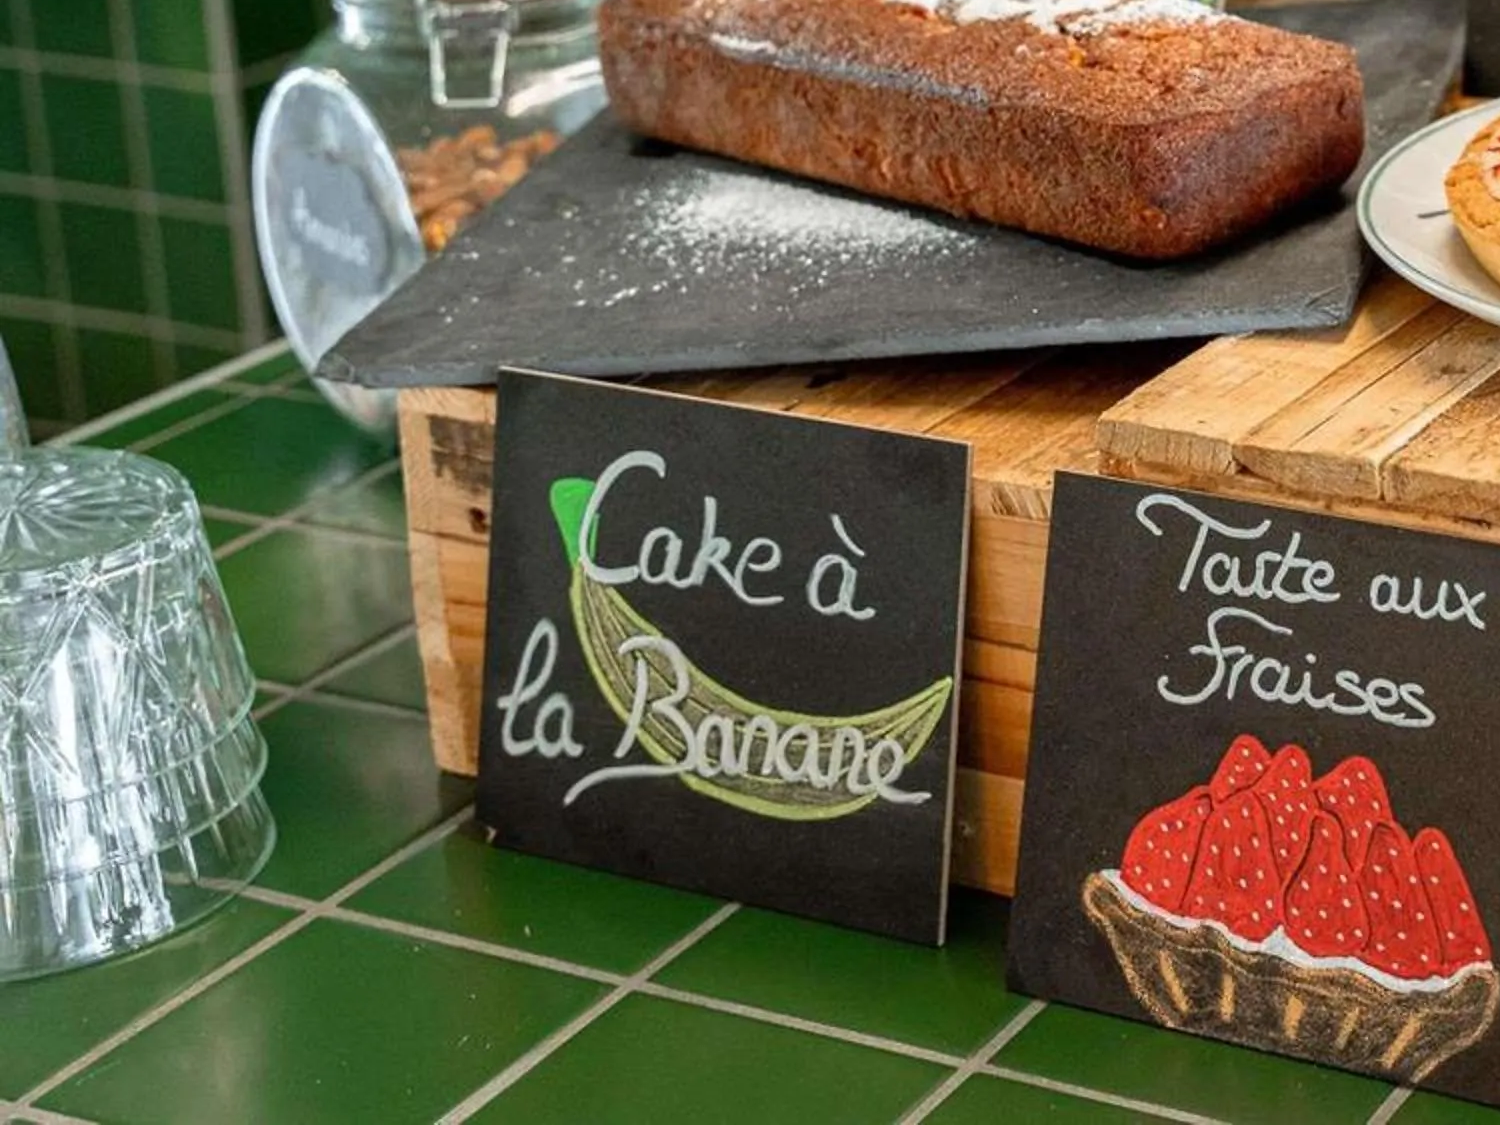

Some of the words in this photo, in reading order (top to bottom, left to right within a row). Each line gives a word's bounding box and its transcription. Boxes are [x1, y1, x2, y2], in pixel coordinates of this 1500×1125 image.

[578, 451, 784, 605] Cake
[806, 514, 876, 619] à
[1136, 494, 1341, 602] Tarte
[1369, 567, 1487, 629] aux
[498, 618, 584, 758] la
[563, 635, 932, 806] Banane
[1157, 607, 1436, 728] Fraises
